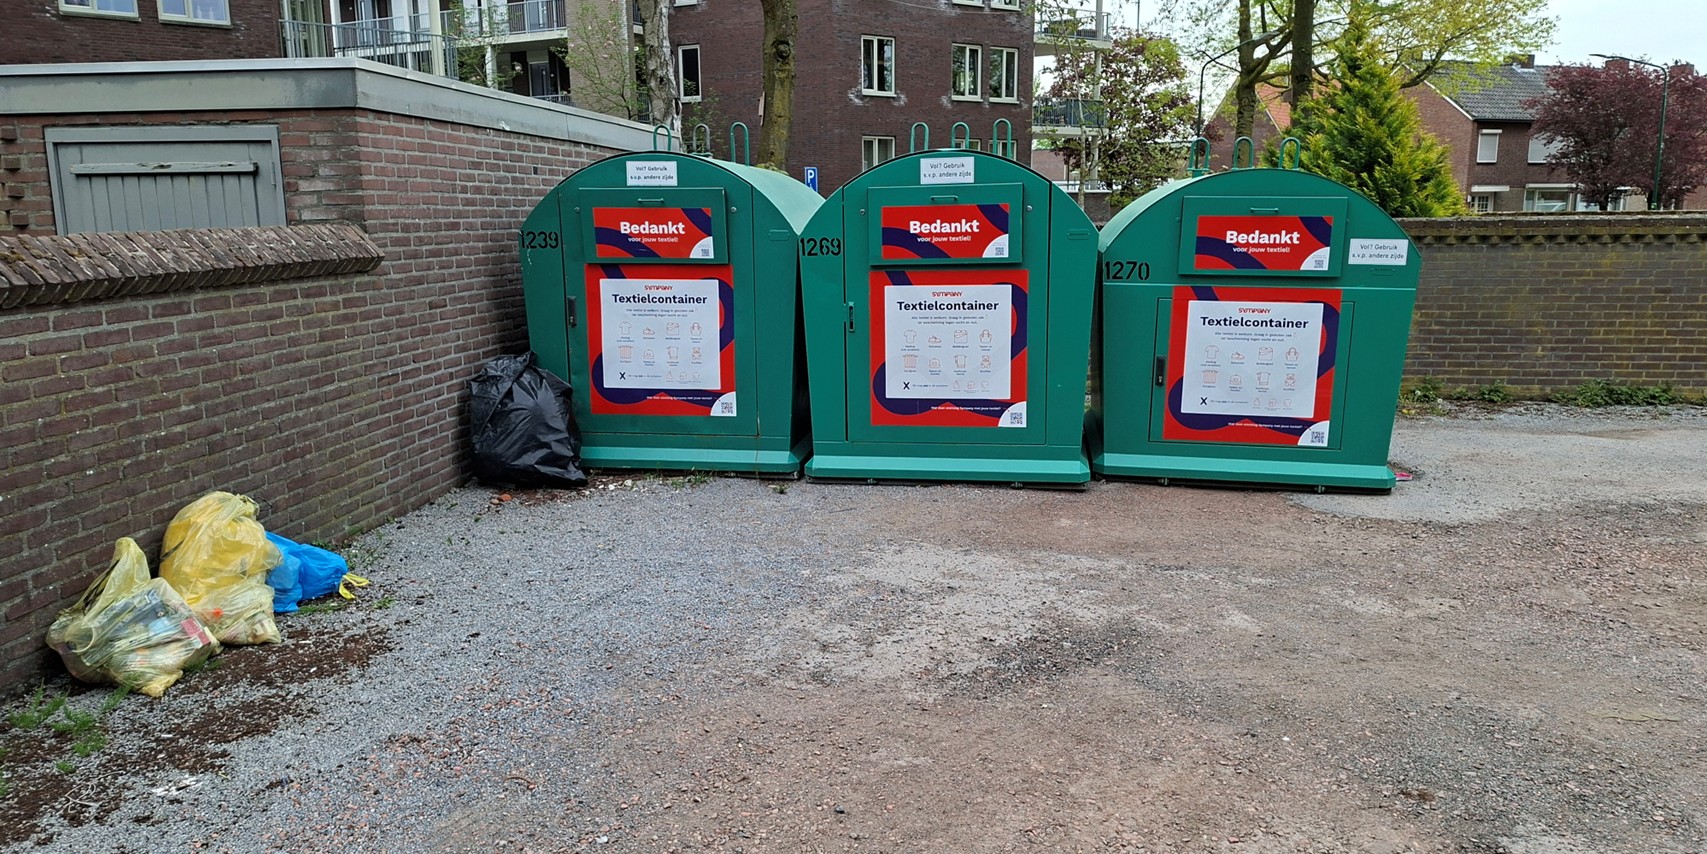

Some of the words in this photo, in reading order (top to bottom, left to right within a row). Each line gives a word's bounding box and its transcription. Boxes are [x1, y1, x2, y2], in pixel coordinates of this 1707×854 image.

[807, 169, 815, 184] P
[958, 170, 972, 178] zijde
[620, 221, 685, 234] Bedankt
[909, 219, 980, 234] Bedankt
[521, 230, 558, 249] 1239
[932, 235, 948, 243] jouw
[1226, 230, 1300, 244] Bedankt
[800, 237, 841, 256] 1269
[1248, 246, 1265, 254] jouw
[1390, 252, 1404, 260] zijde
[1105, 261, 1150, 280] 1270
[611, 293, 708, 304] Textielcontainer
[897, 300, 999, 311] Textielcontainer
[1200, 316, 1309, 329] Textielcontainer
